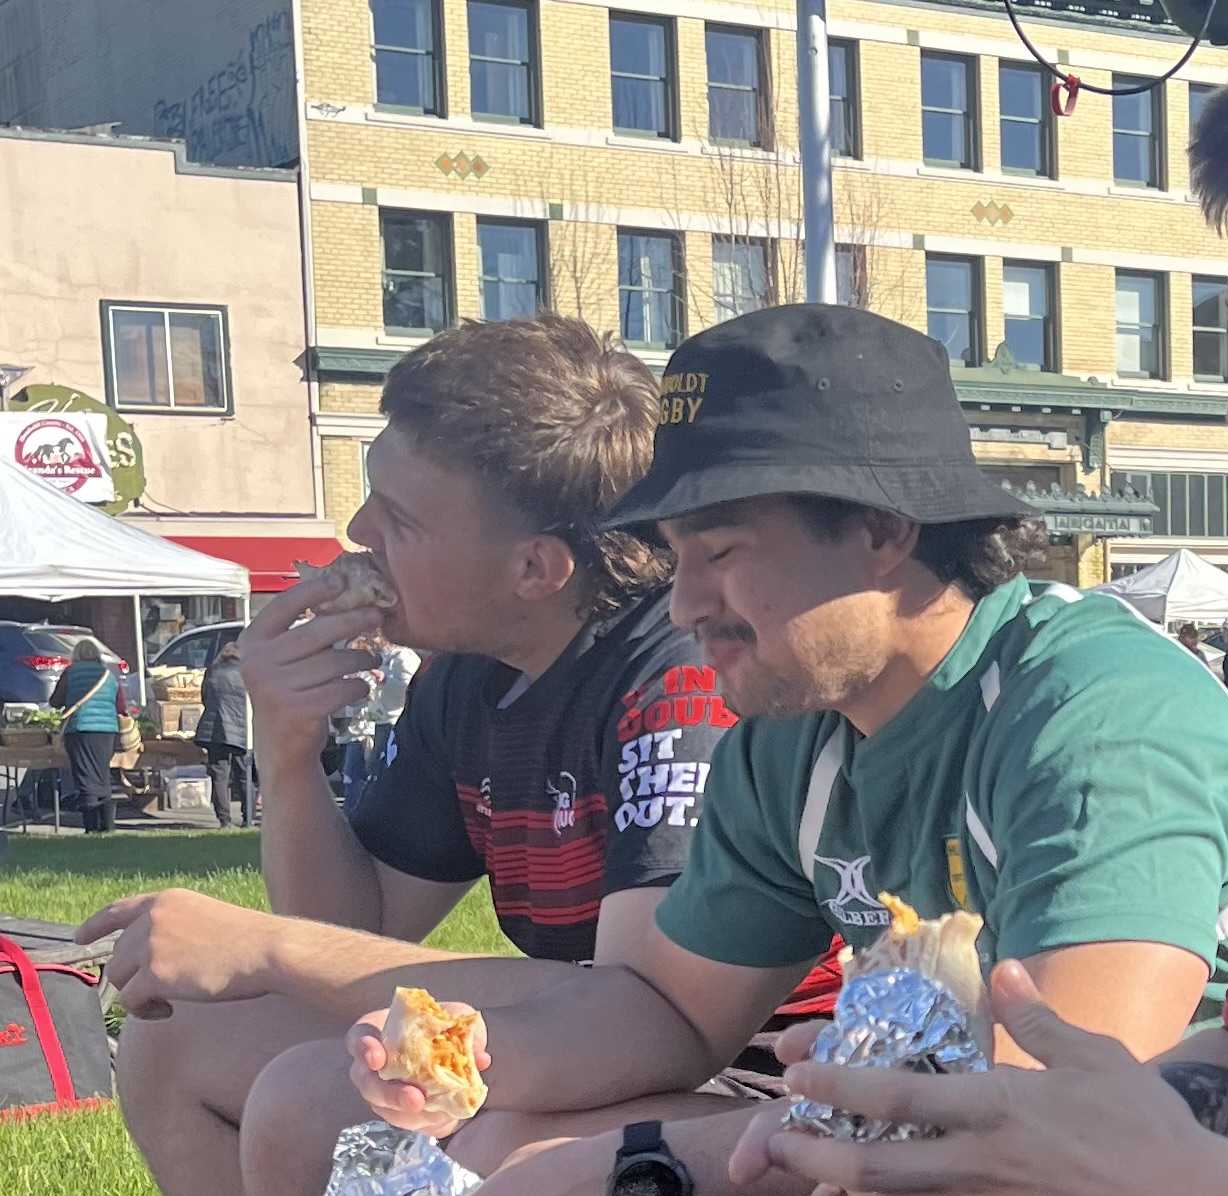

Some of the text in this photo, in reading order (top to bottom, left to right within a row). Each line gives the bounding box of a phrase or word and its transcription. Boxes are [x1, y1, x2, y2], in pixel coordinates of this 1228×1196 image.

[664, 665, 716, 695] IN
[617, 695, 740, 742] DOUB
[618, 728, 683, 774] SIT
